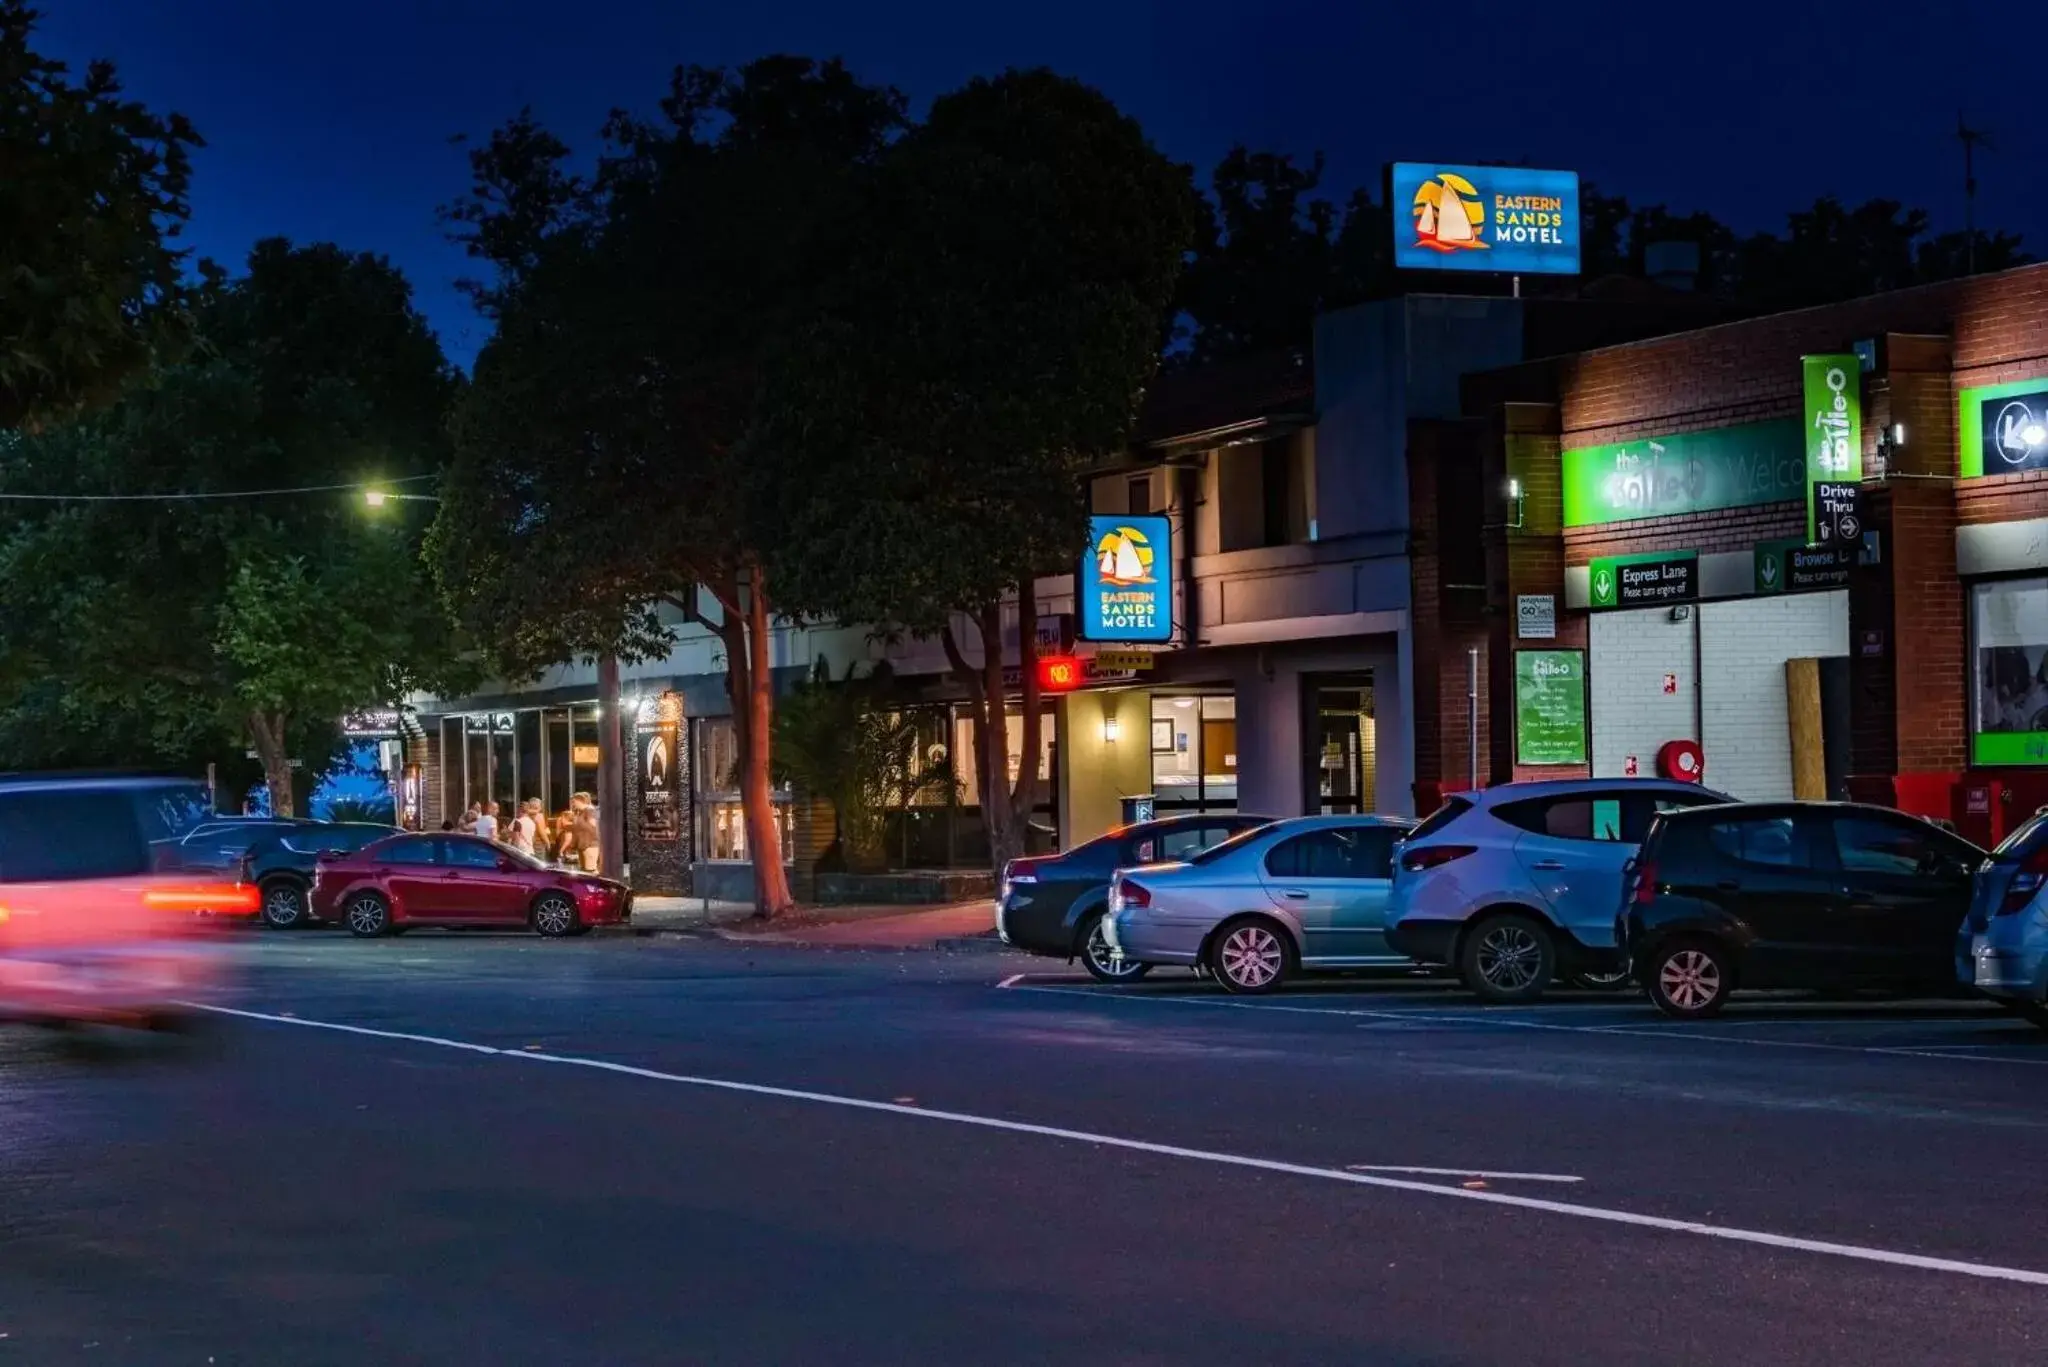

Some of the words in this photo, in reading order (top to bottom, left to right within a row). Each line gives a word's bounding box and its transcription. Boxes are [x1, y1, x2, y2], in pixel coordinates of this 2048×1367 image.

[1495, 194, 1561, 211] EASTERN
[1495, 210, 1562, 227] SANDS
[1496, 226, 1562, 244] MOTEL
[1820, 484, 1856, 498] Drive
[1823, 499, 1854, 513] Thru
[1793, 551, 1835, 568] Browse
[1622, 568, 1659, 586] Express
[1662, 563, 1688, 580] Lane
[1101, 591, 1155, 603] EASTERN
[1101, 603, 1156, 615] SANDS
[1102, 615, 1155, 628] MOTEL
